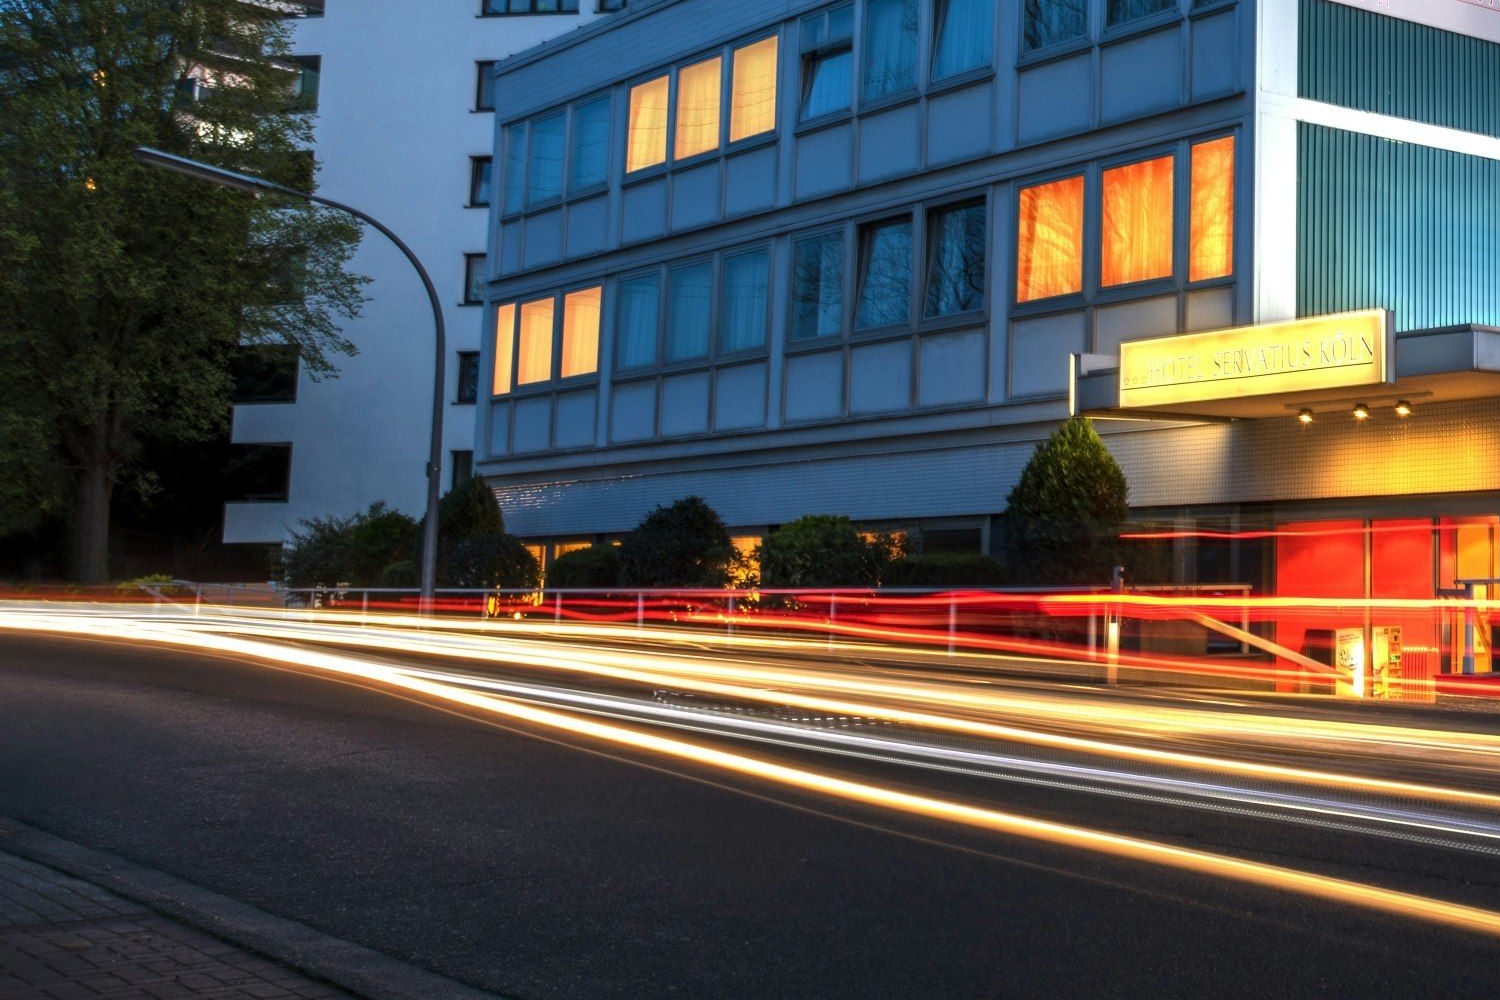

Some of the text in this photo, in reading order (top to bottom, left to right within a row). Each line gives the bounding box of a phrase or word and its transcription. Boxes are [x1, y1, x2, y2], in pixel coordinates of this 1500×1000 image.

[1149, 331, 1375, 383] HOTEL SERVATIUS KÖLN
